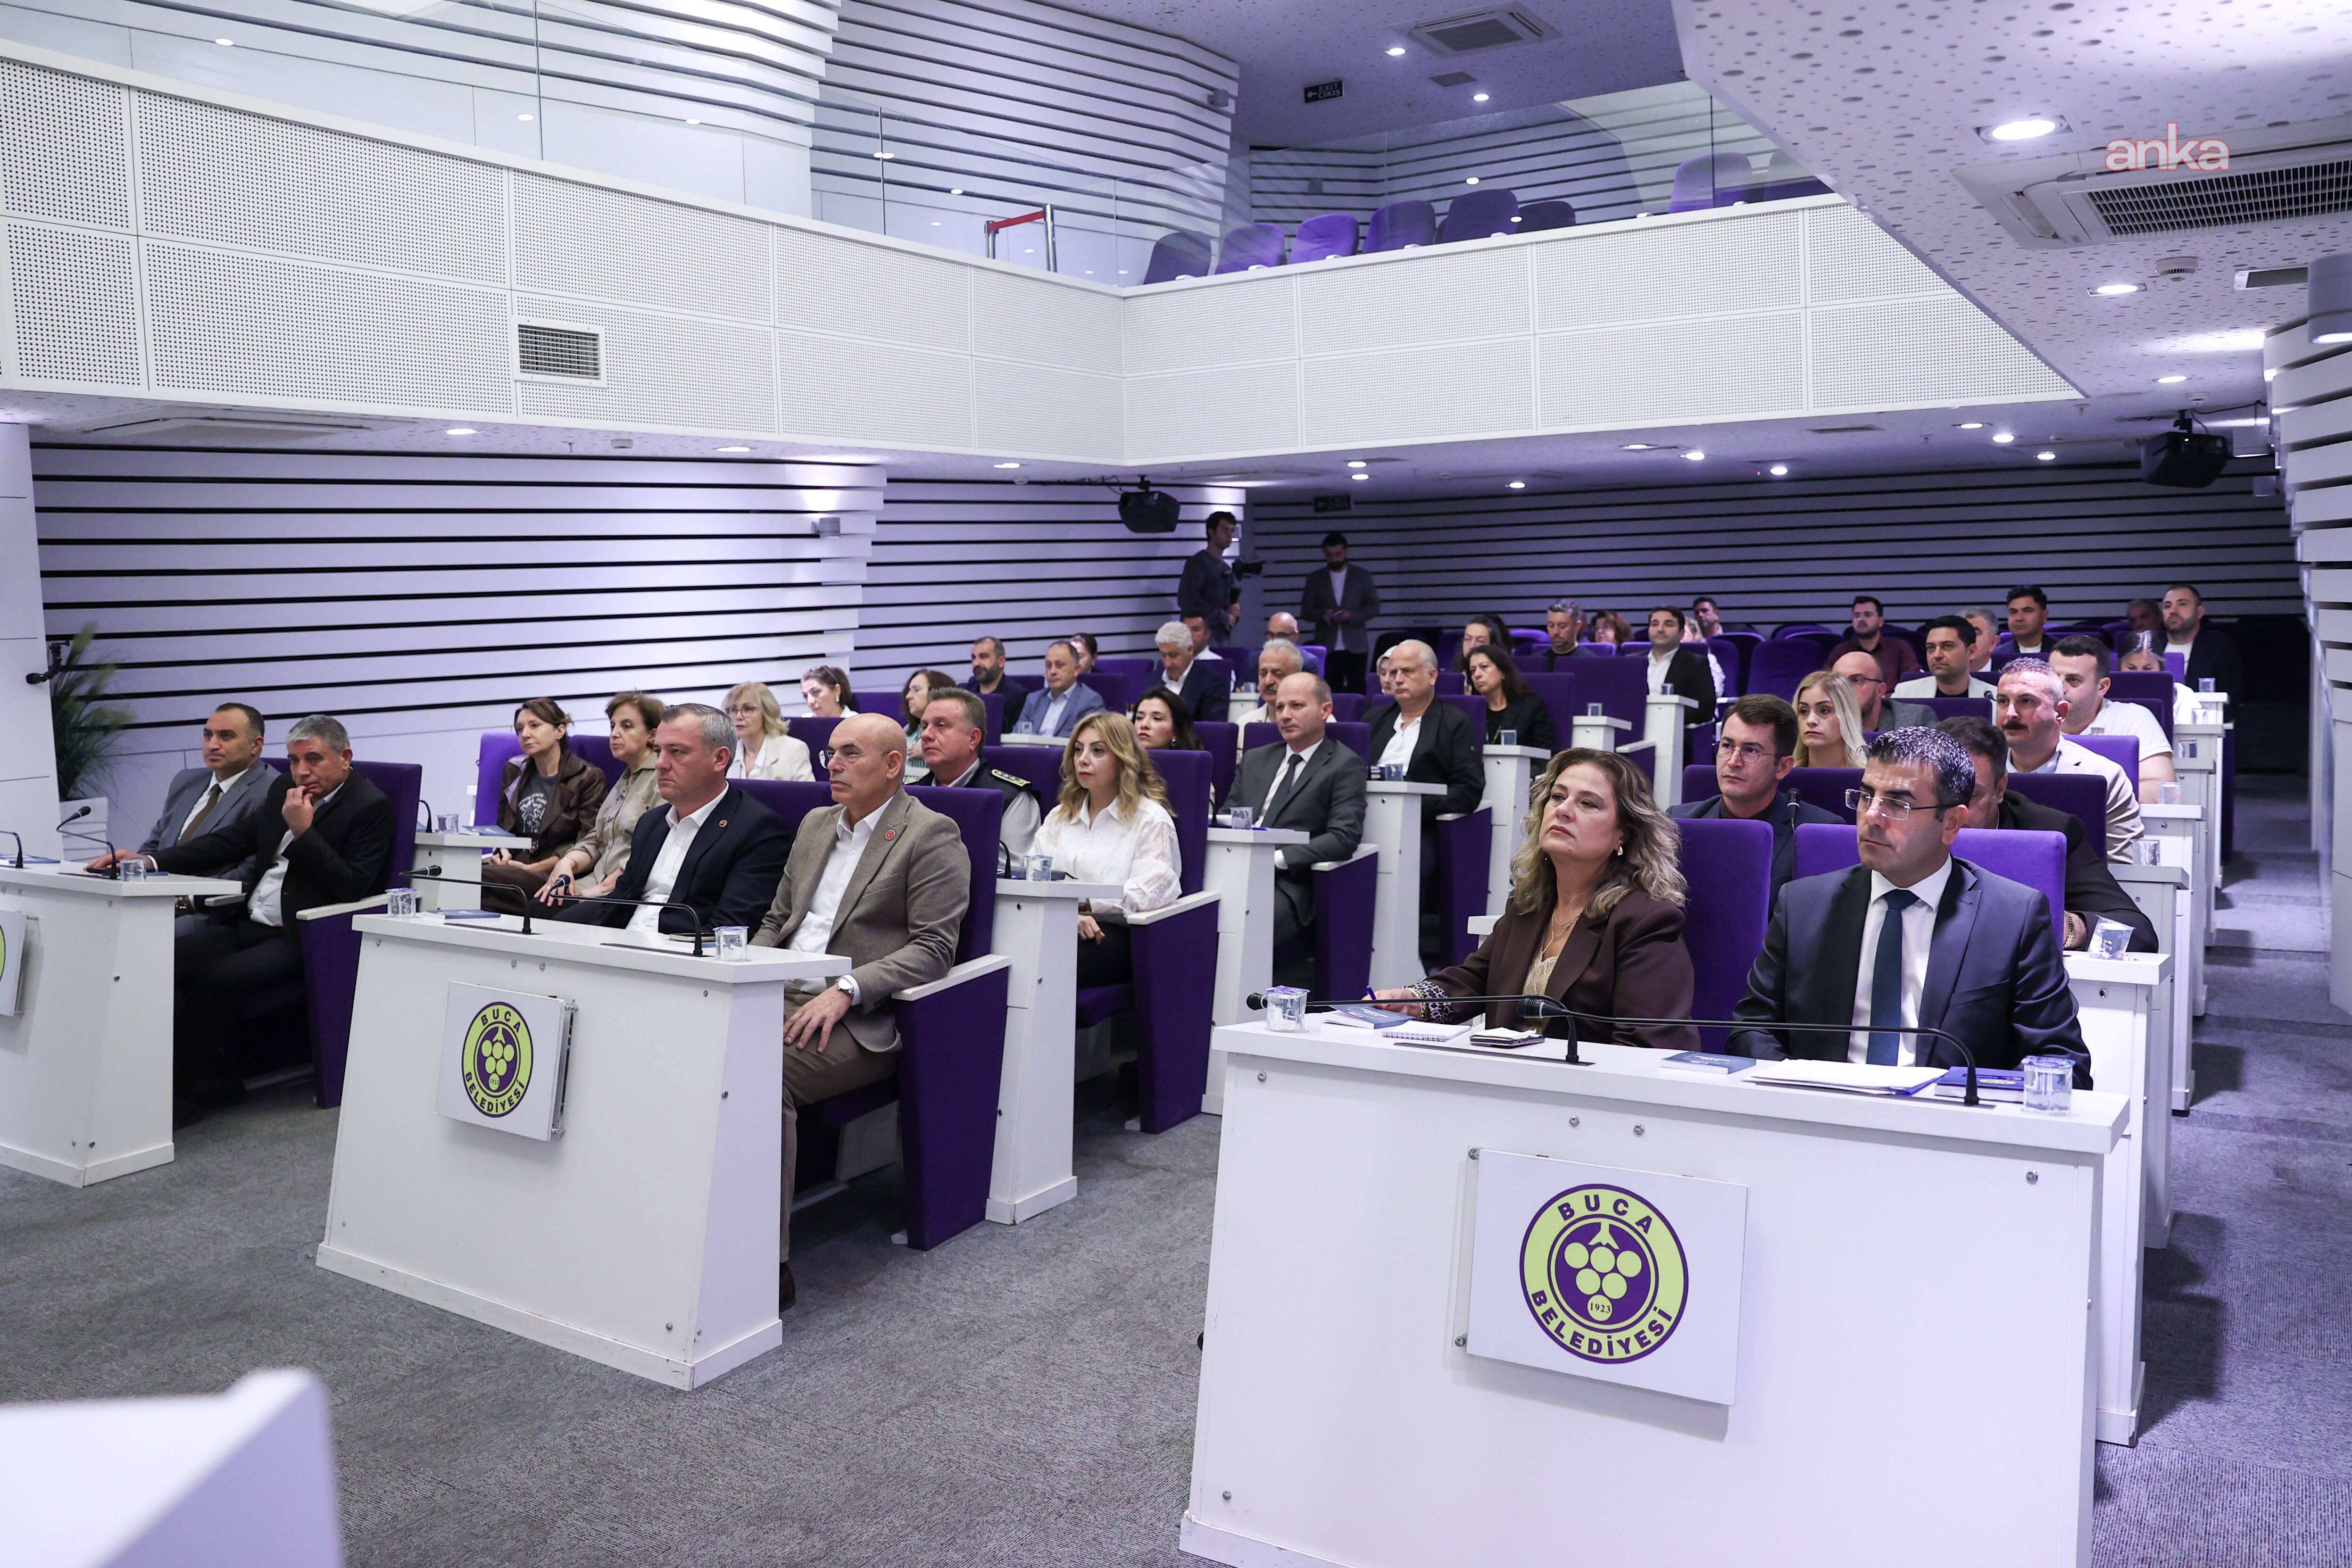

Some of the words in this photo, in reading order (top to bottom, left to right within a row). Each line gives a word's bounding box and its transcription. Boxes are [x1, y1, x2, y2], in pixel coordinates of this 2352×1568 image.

[1319, 83, 1338, 91] EXIT
[481, 1008, 521, 1033] BUCA
[465, 1071, 524, 1113] BELEDİYESİ
[1557, 1194, 1653, 1234] BUCA
[1531, 1290, 1672, 1356] BELEDİYESİ
[1590, 1302, 1611, 1313] 1923
